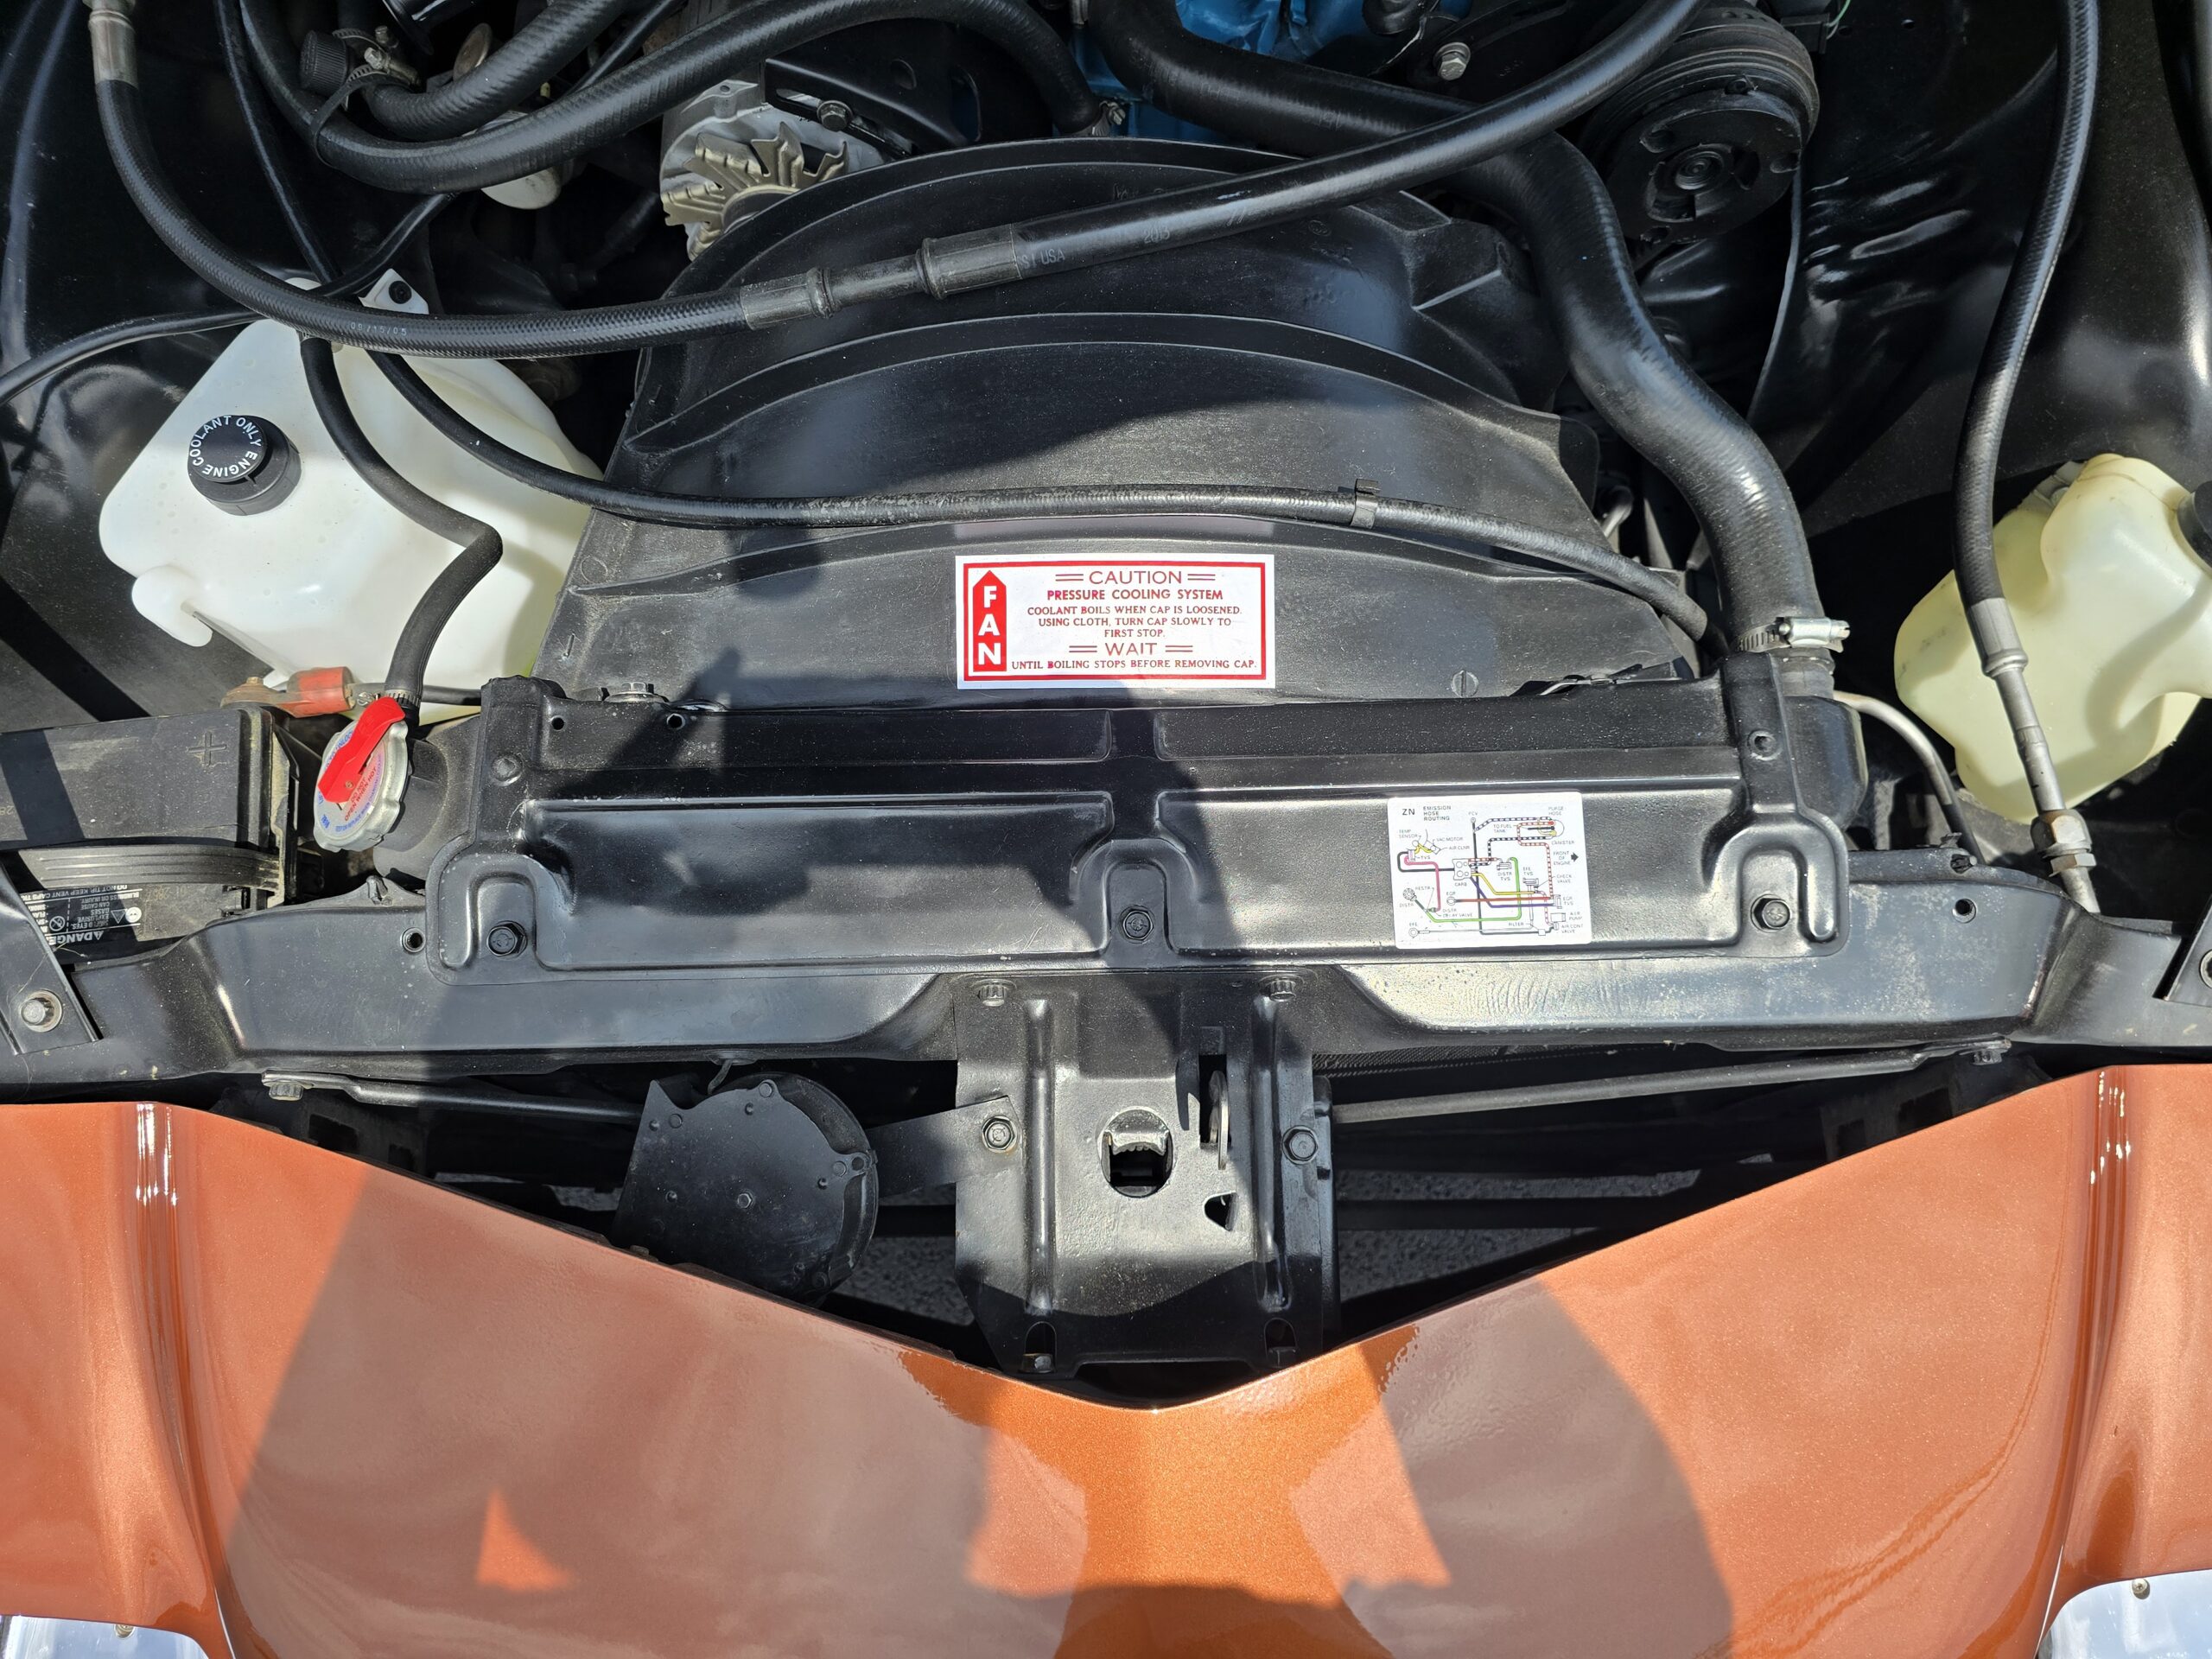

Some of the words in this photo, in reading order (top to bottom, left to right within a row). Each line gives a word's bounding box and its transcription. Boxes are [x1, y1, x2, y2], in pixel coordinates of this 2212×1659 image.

[1040, 248, 1065, 266] USA
[235, 417, 261, 447] ONLY
[190, 415, 232, 467] COOLANT
[202, 451, 258, 477] ENGINE
[1088, 570, 1182, 585] CAUTION
[1047, 589, 1105, 601] PRESSURE
[1112, 589, 1170, 600] COOLING
[1177, 588, 1223, 600] SYSTEM
[1027, 606, 1077, 616] COOLANT
[1081, 606, 1111, 615] BOILS
[1114, 605, 1147, 615] WHEN
[1149, 606, 1171, 615] CAP
[1173, 606, 1183, 614] IS
[1185, 605, 1243, 615] LOOSENED.
[978, 585, 1001, 665] FAN
[1038, 617, 1070, 627] USING
[1073, 617, 1112, 628] CLOTH,
[1114, 617, 1144, 626] TURN
[1147, 617, 1168, 626] CAP
[1170, 617, 1214, 626] SLOWLY
[1217, 617, 1231, 626] TO
[1104, 629, 1134, 638] FIRST
[1137, 629, 1166, 638] STOP.
[1105, 642, 1158, 656] WAIT
[1012, 660, 1043, 669] UNTIL
[1047, 660, 1090, 669] BOILING
[1094, 660, 1126, 669] STOPS
[1130, 660, 1171, 669] BEFORE
[1174, 660, 1231, 669] REMOVING
[1234, 660, 1258, 669] CAP.
[345, 802, 357, 821] OPEN
[356, 782, 369, 802] WHEN
[368, 767, 377, 781] HOT
[351, 791, 358, 803] DO
[45, 931, 93, 946] DANGE
